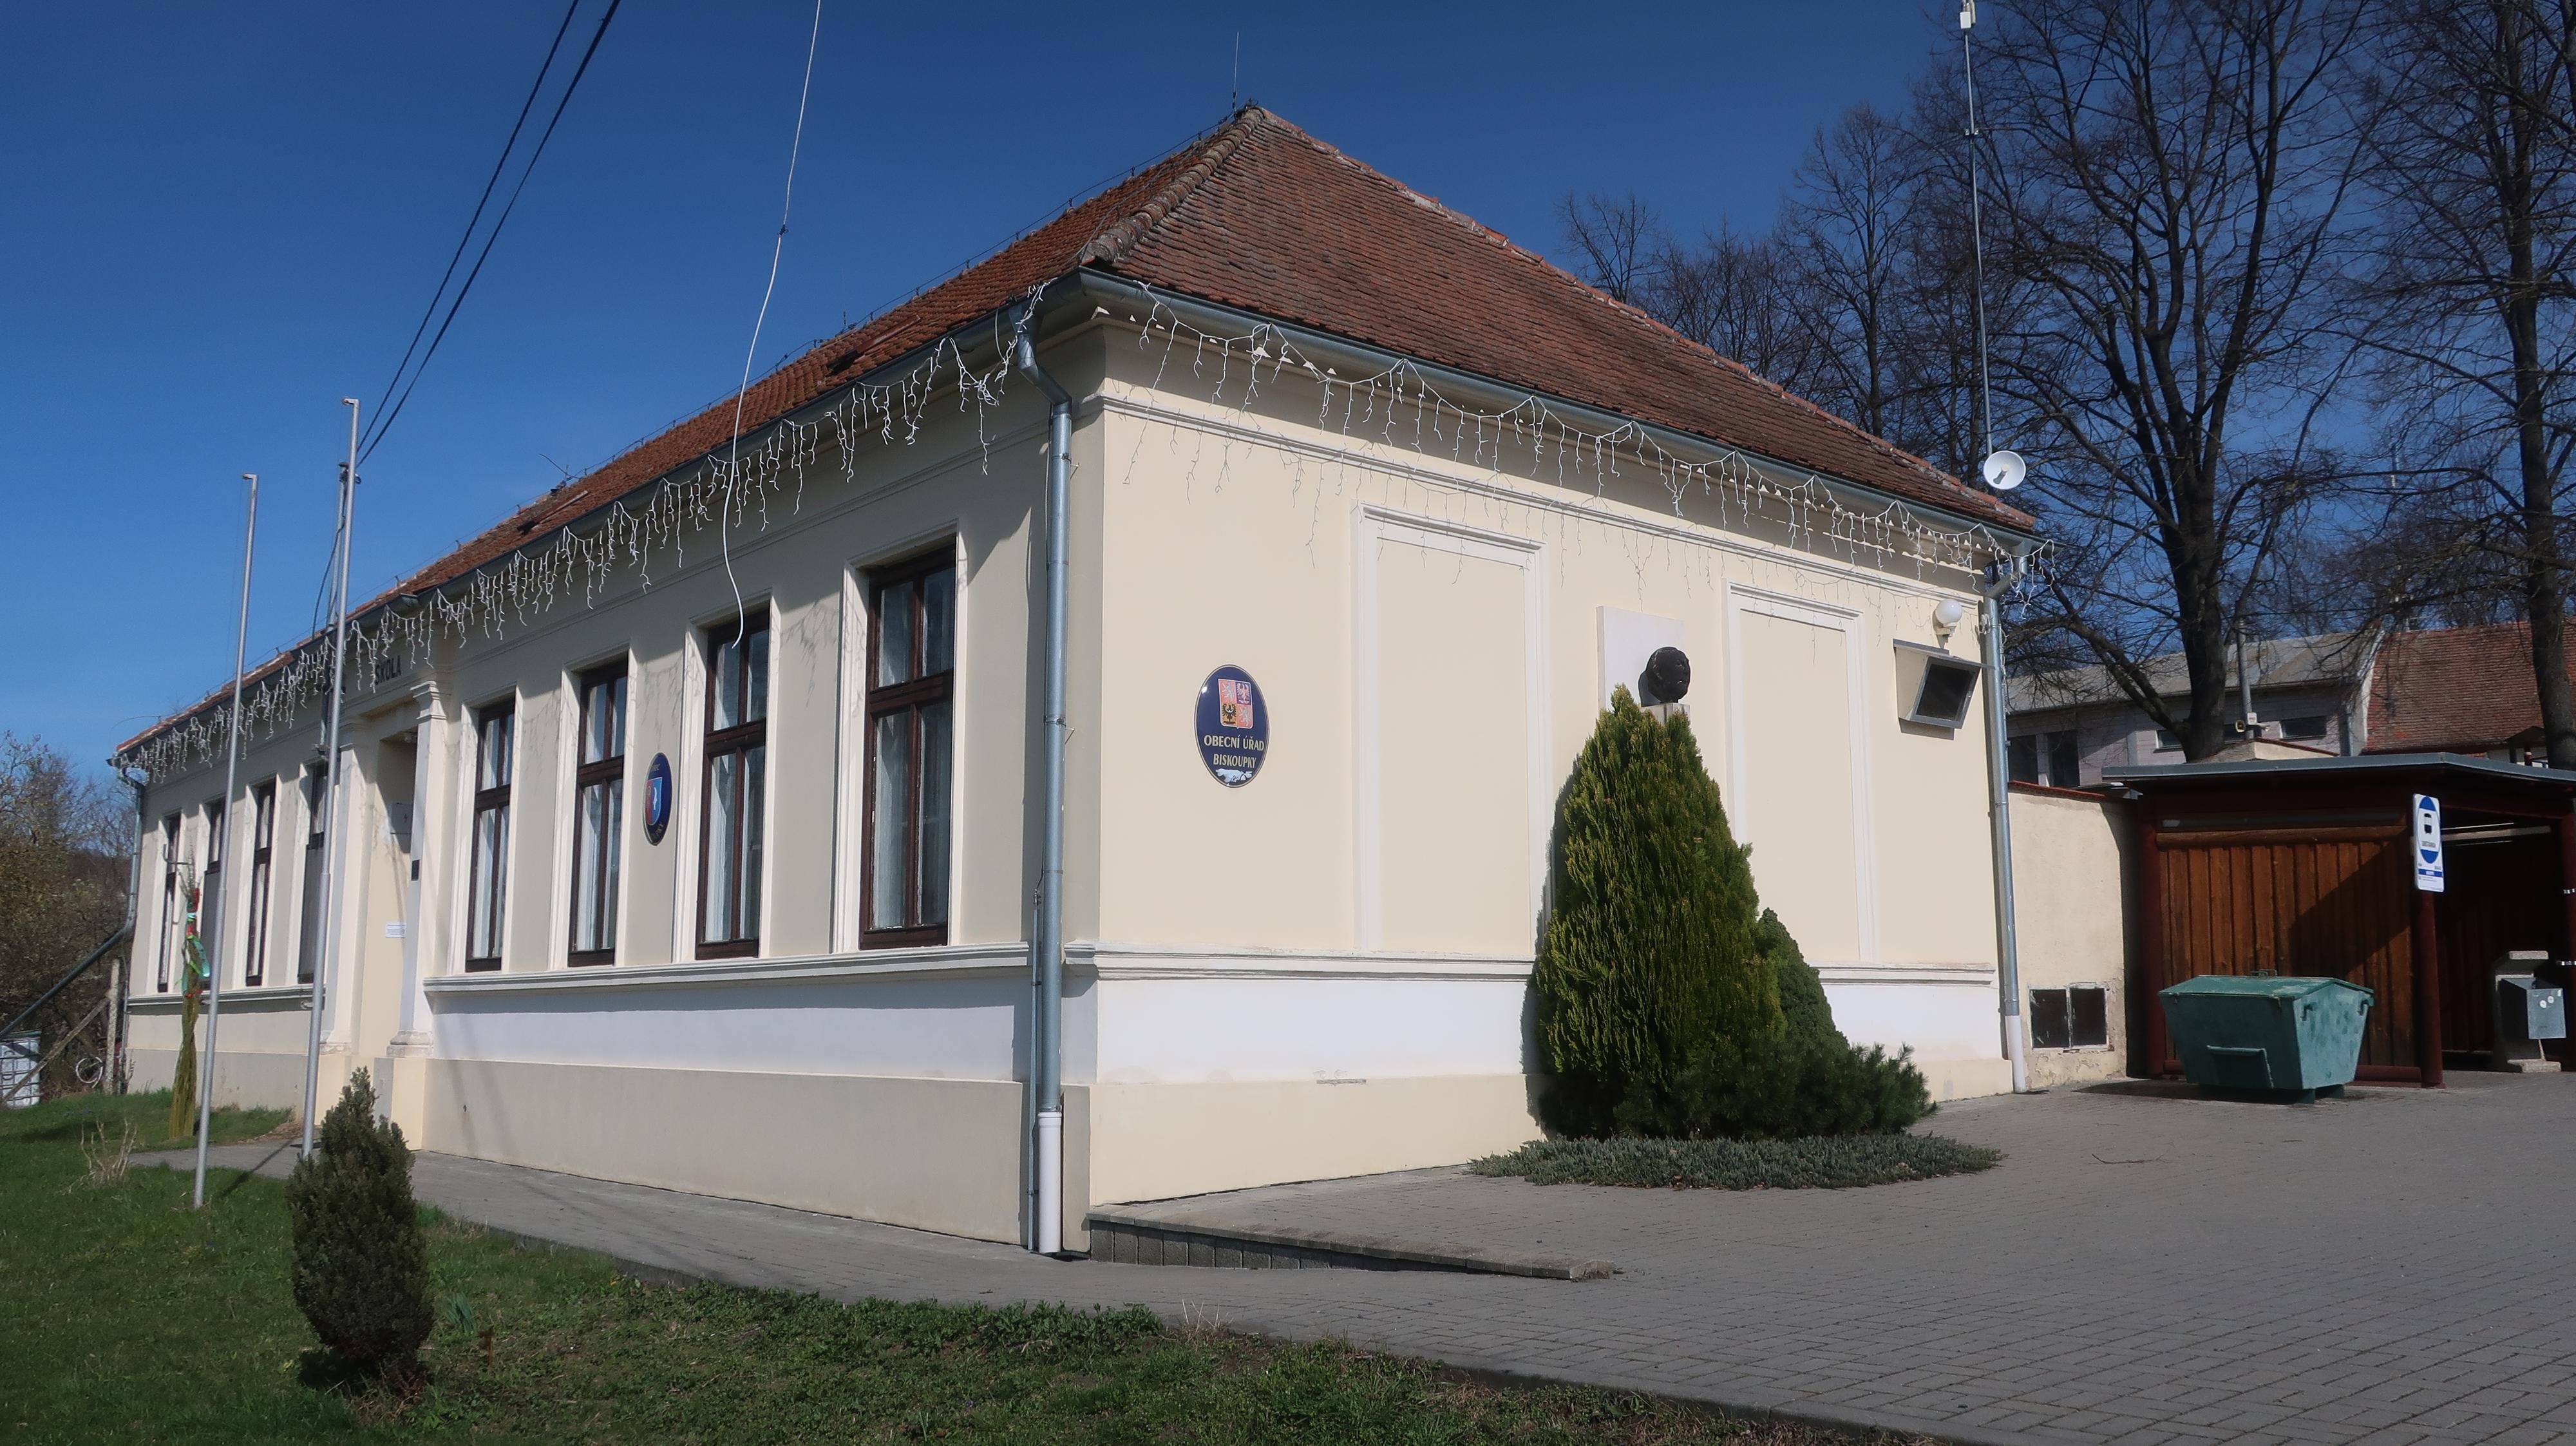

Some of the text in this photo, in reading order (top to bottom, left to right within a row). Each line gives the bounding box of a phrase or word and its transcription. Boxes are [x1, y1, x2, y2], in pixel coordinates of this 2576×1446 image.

[1204, 734, 1265, 751] OBECNÍ ÚŘAD
[1213, 753, 1257, 768] BISKOUPKY
